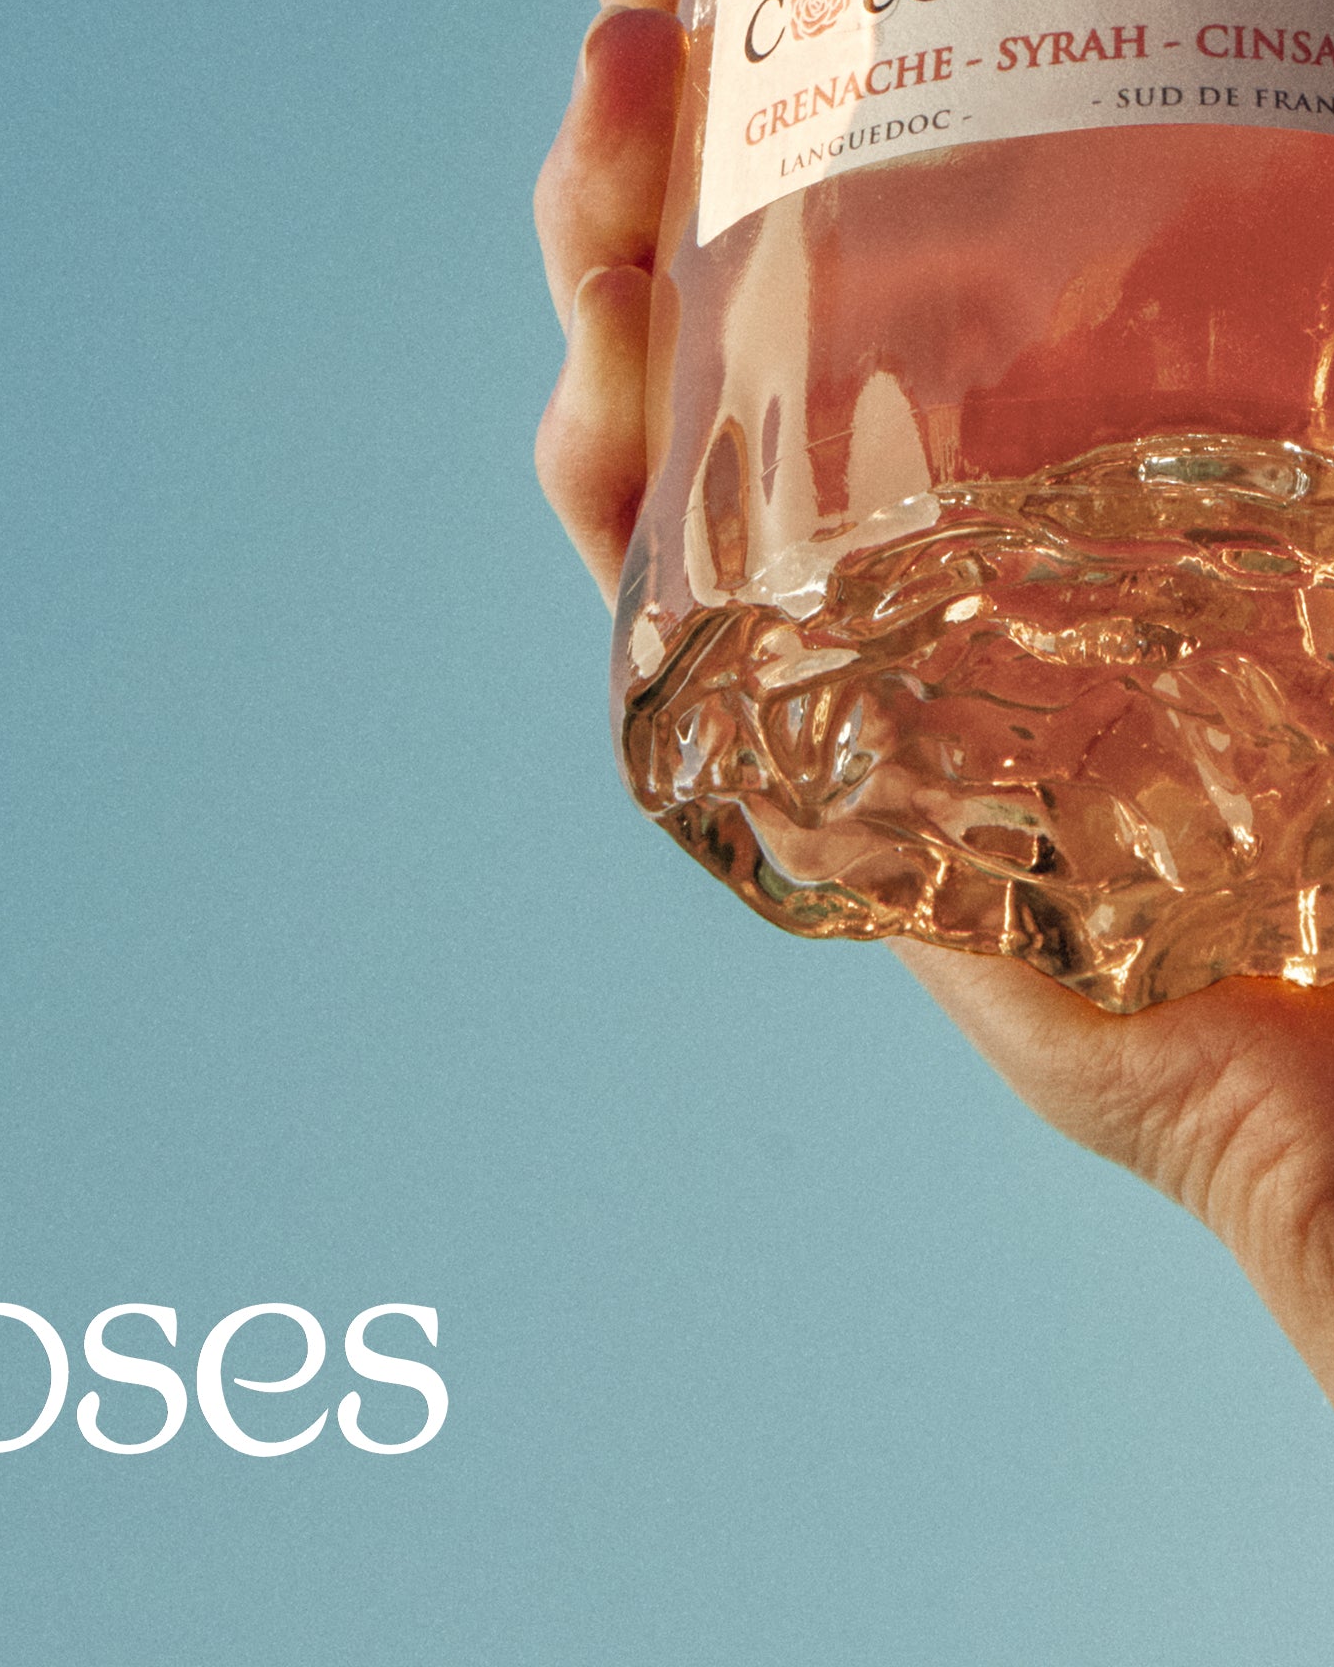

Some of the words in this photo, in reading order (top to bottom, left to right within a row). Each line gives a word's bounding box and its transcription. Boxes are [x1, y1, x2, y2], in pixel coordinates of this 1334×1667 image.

[744, 45, 954, 147] GRENACHE
[995, 24, 1149, 72] SYRAH
[779, 108, 952, 178] LANGUEDOC
[1116, 86, 1184, 109] SUD
[1198, 85, 1240, 108] DE
